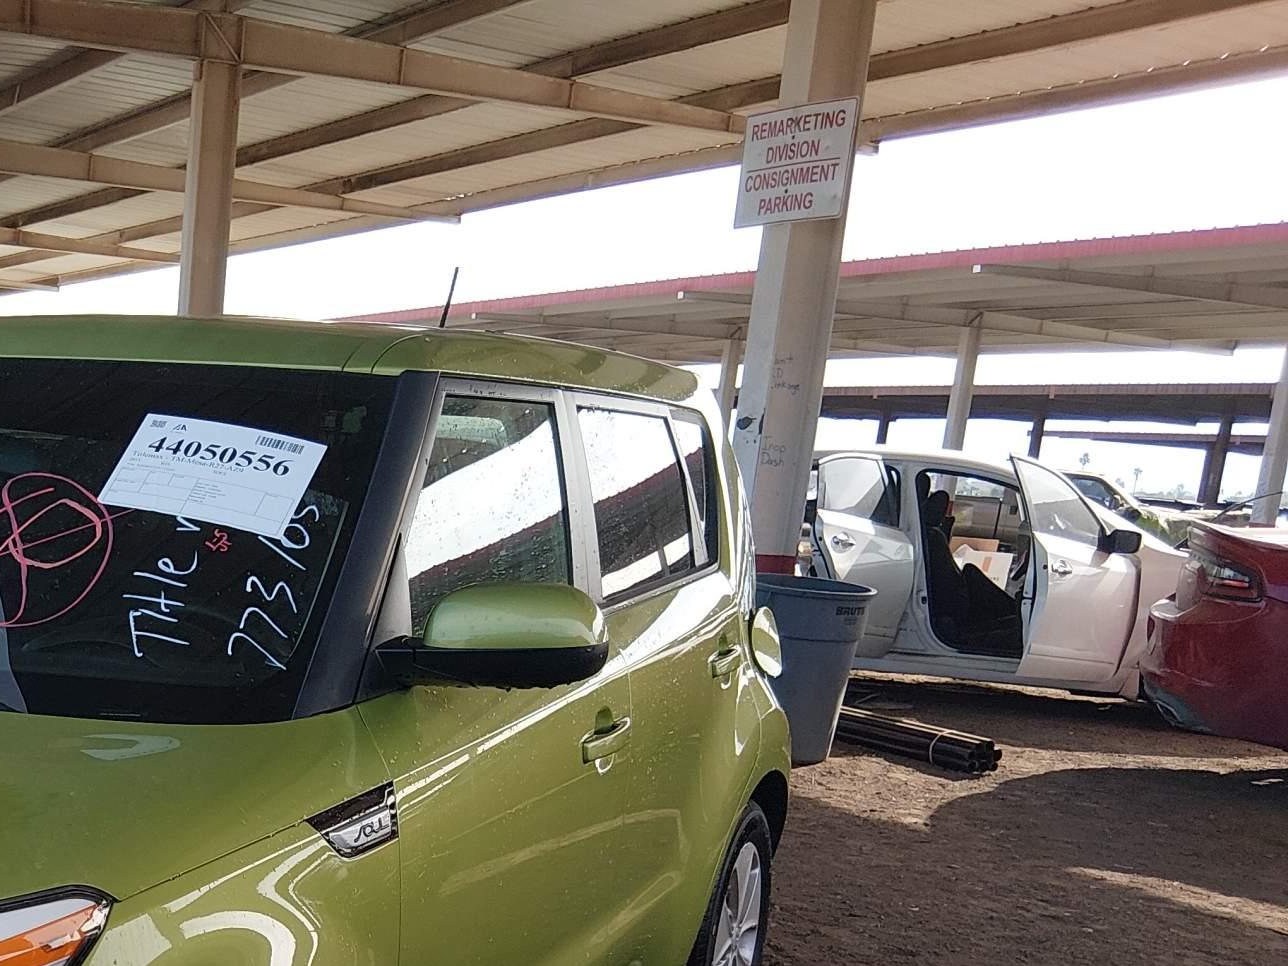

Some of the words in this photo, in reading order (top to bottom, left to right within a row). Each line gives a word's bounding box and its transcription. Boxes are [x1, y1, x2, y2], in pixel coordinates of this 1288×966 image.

[751, 109, 846, 142] REMARKETING
[766, 139, 821, 164] DIVISION
[744, 163, 840, 193] CONSIGNMENT
[757, 192, 814, 217] PARKING
[148, 436, 297, 477] 44050556
[122, 550, 198, 658] Title
